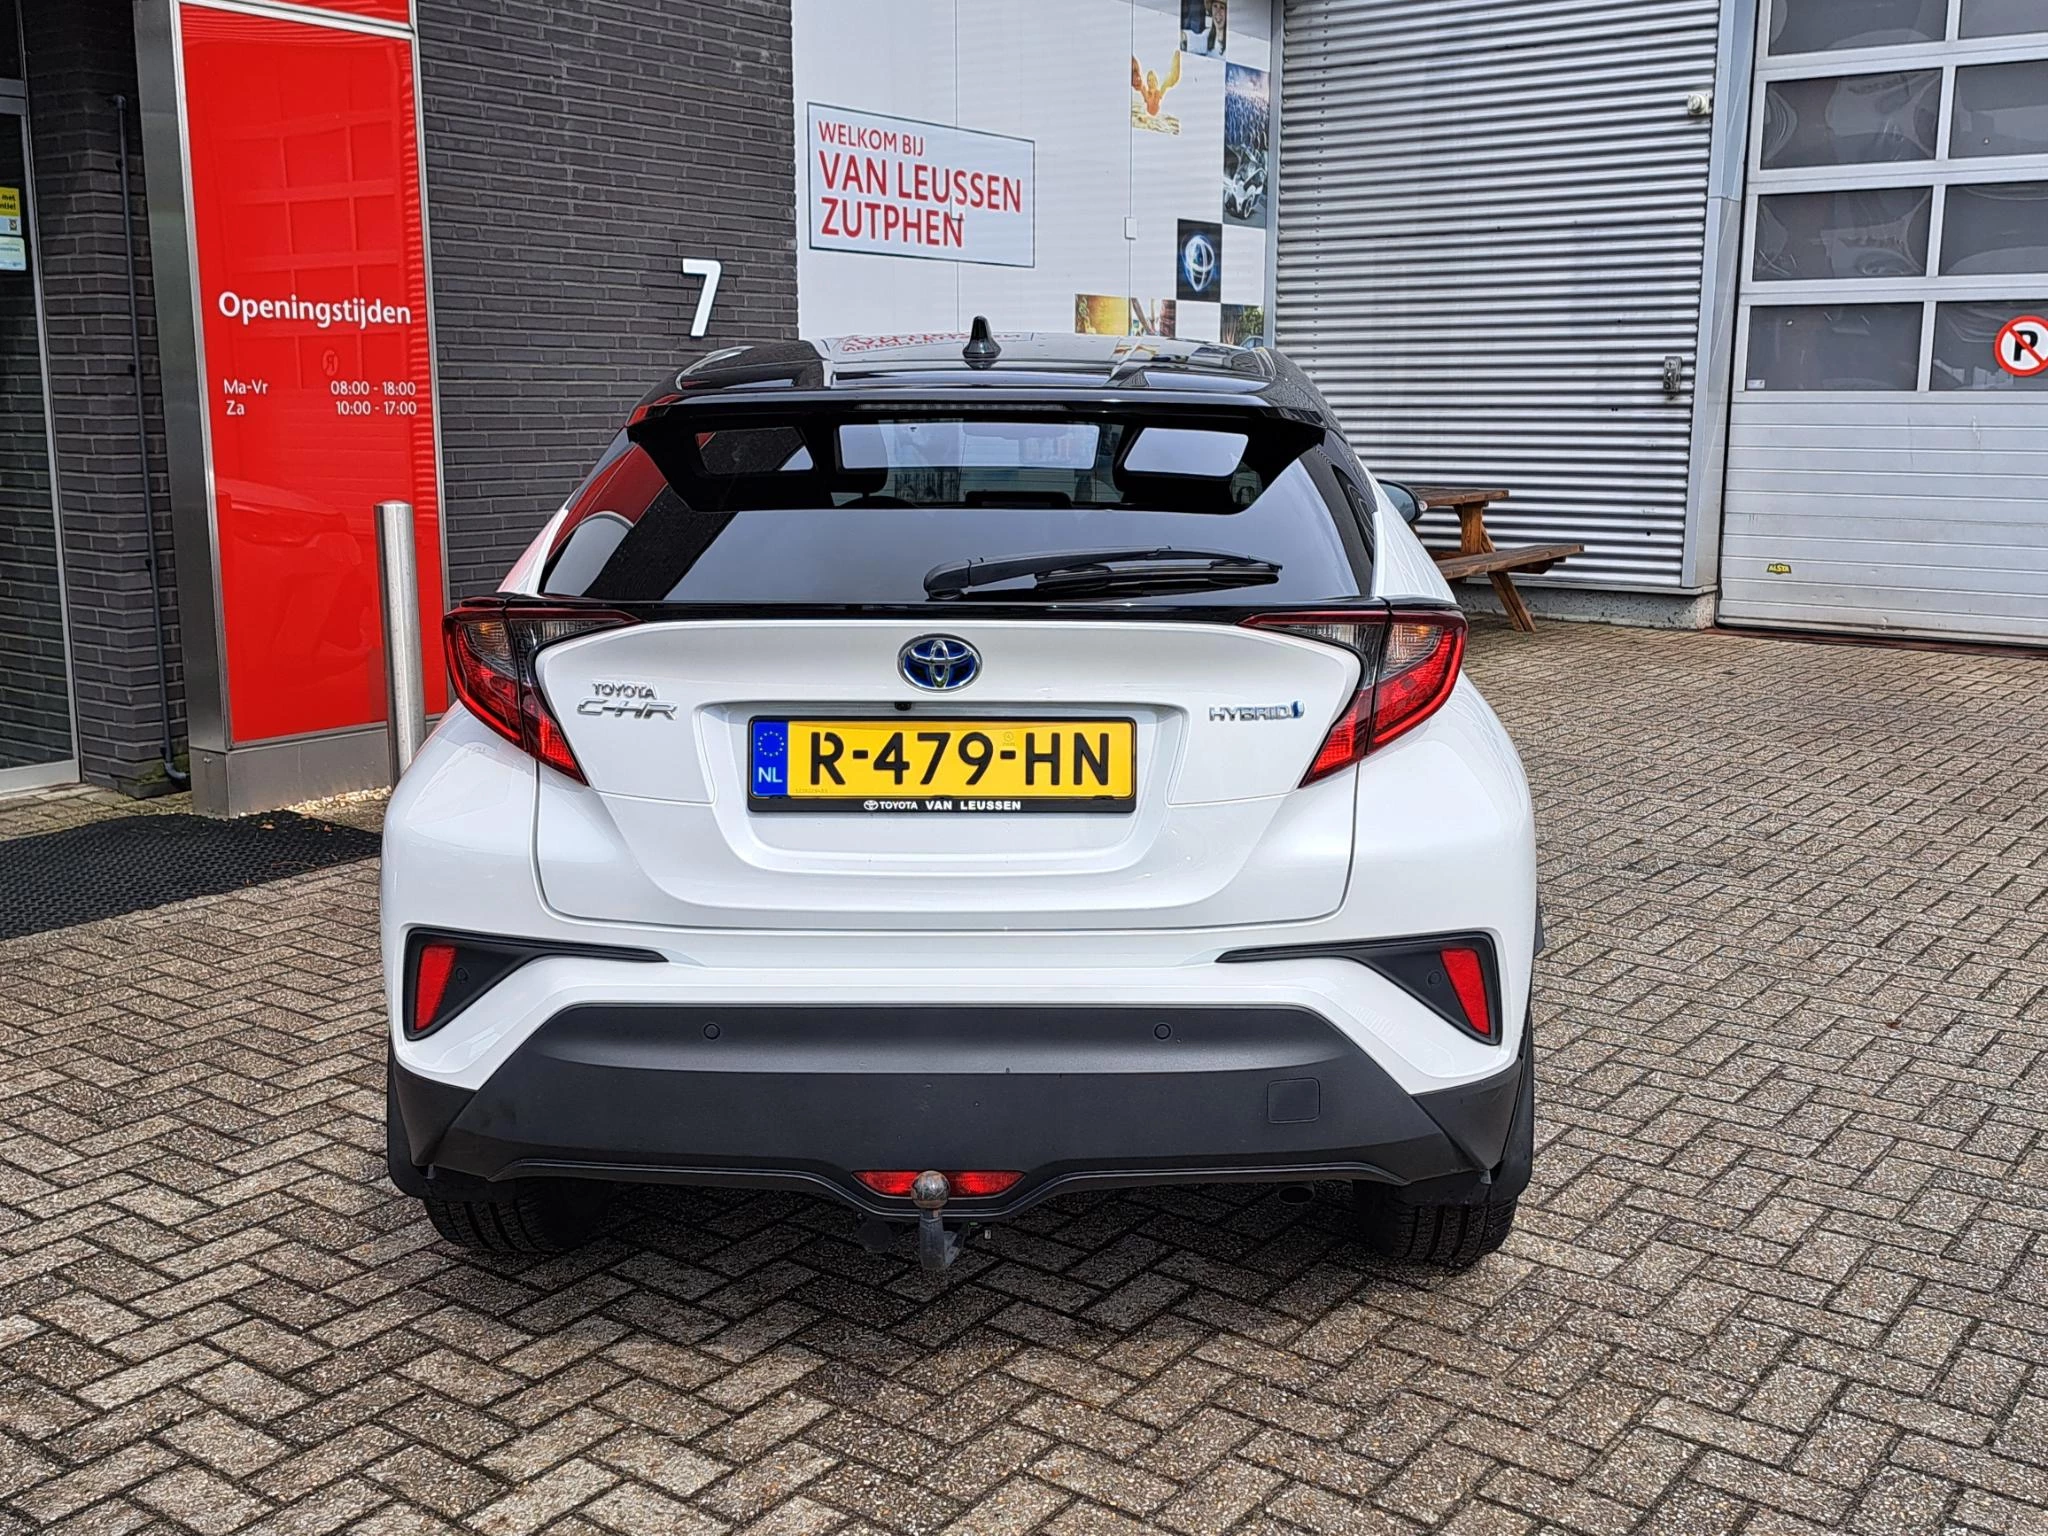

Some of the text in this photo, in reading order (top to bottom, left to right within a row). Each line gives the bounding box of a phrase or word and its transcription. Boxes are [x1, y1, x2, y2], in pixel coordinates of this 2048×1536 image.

[818, 121, 924, 157] WELKOM BIJ
[819, 150, 1021, 213] VAN LEUSSEN
[821, 197, 964, 248] ZUTPHEN
[218, 291, 412, 329] Openingstijden
[682, 258, 722, 337] 7
[2013, 330, 2039, 362] P
[223, 378, 268, 395] Ma-Vr
[330, 380, 370, 396] 08:00
[382, 381, 416, 396] 18:00
[226, 400, 245, 416] Za
[336, 400, 371, 416] 10:00
[384, 401, 417, 416] 17:00
[592, 681, 658, 700] TOYOTA
[577, 698, 678, 720] C-HR
[1208, 705, 1290, 721] HYBRID
[809, 731, 1109, 786] R-479-HN
[758, 767, 783, 784] NL
[879, 800, 1021, 811] TOYOTA VAN LEUSSEN
